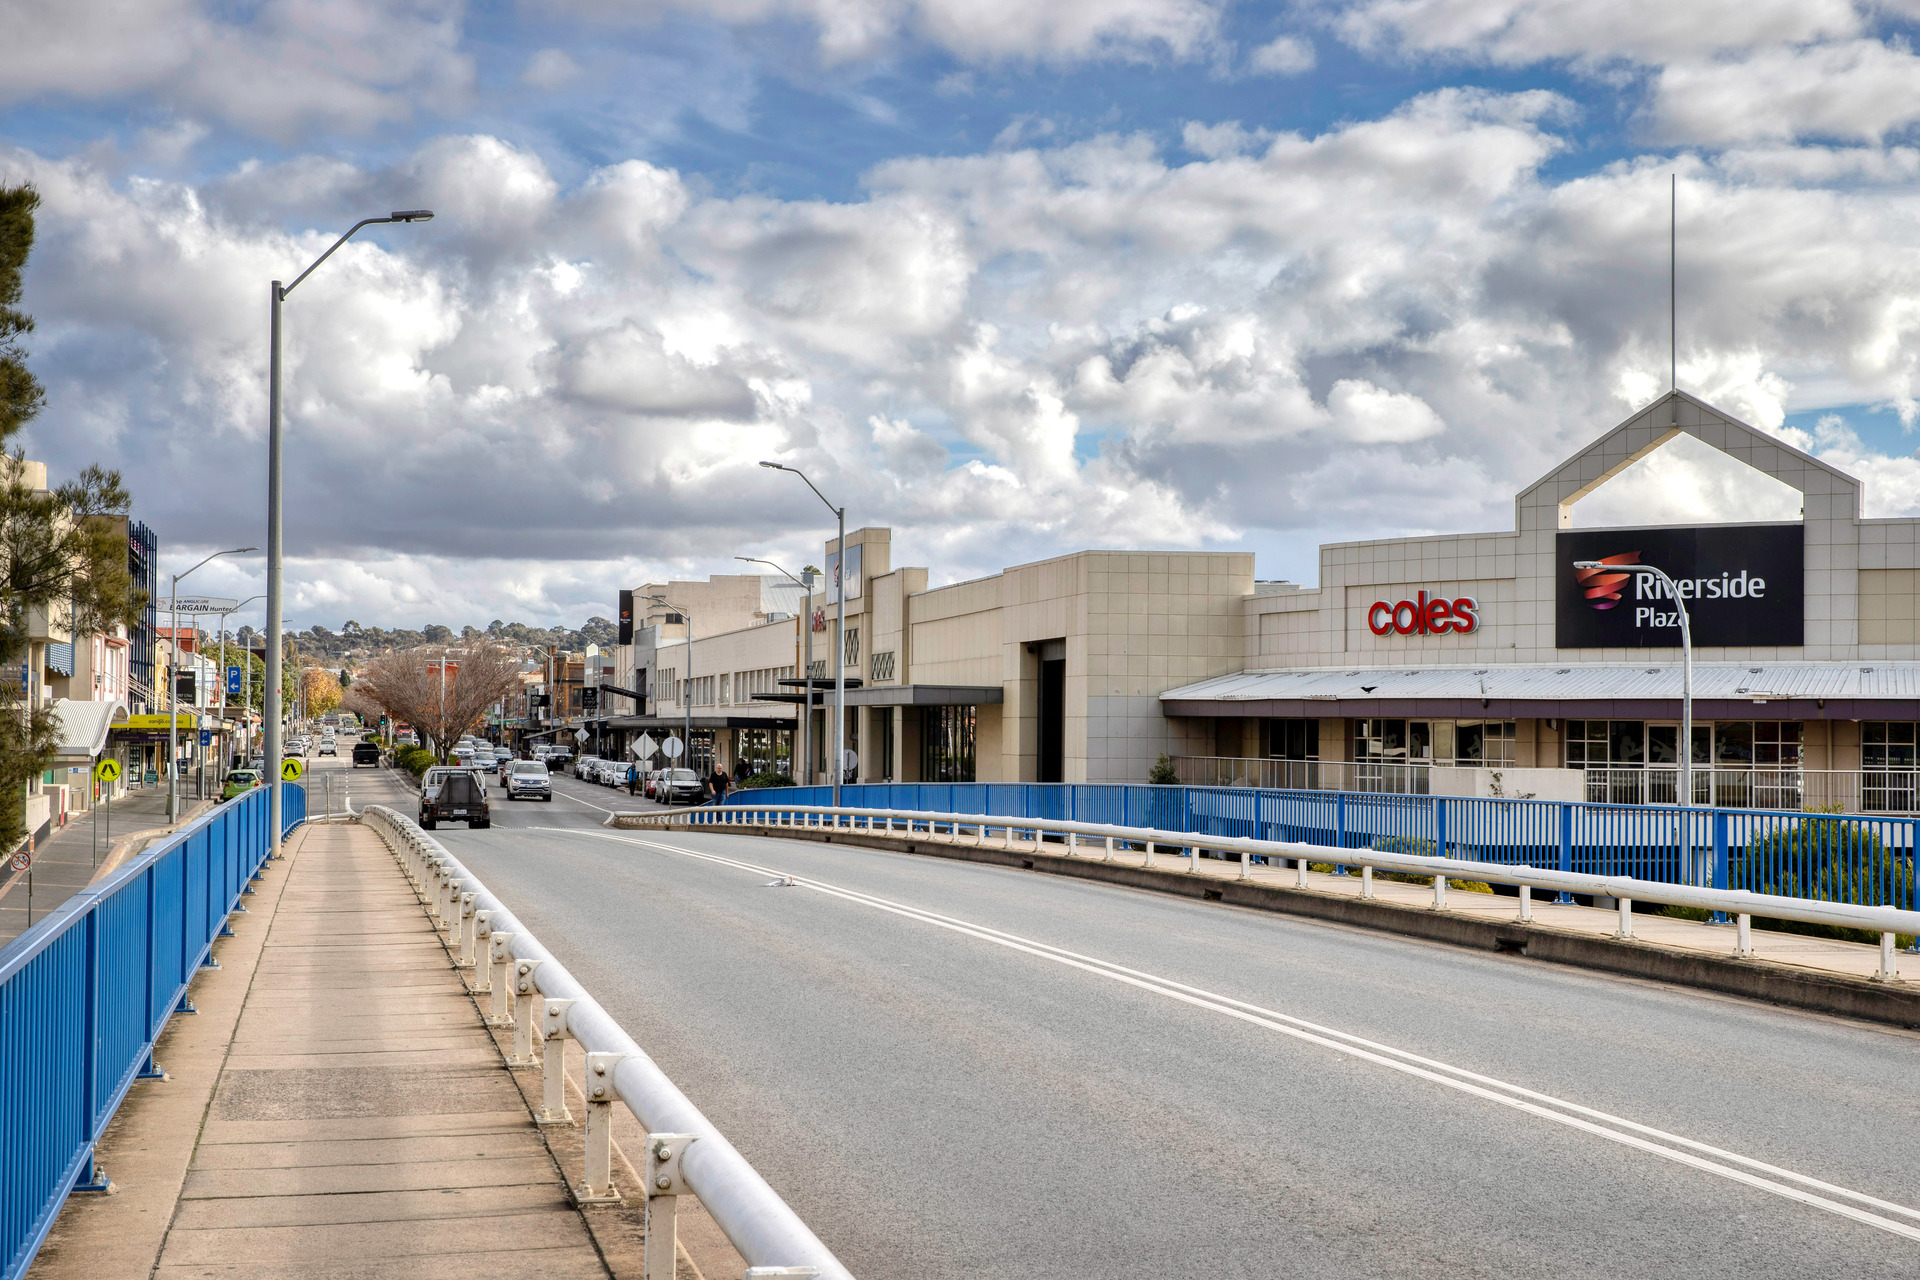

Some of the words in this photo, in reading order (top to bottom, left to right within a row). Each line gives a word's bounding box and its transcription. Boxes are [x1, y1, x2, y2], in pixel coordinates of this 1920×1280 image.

[1635, 570, 1766, 600] Riverside
[1368, 590, 1479, 635] coles
[230, 670, 238, 678] P
